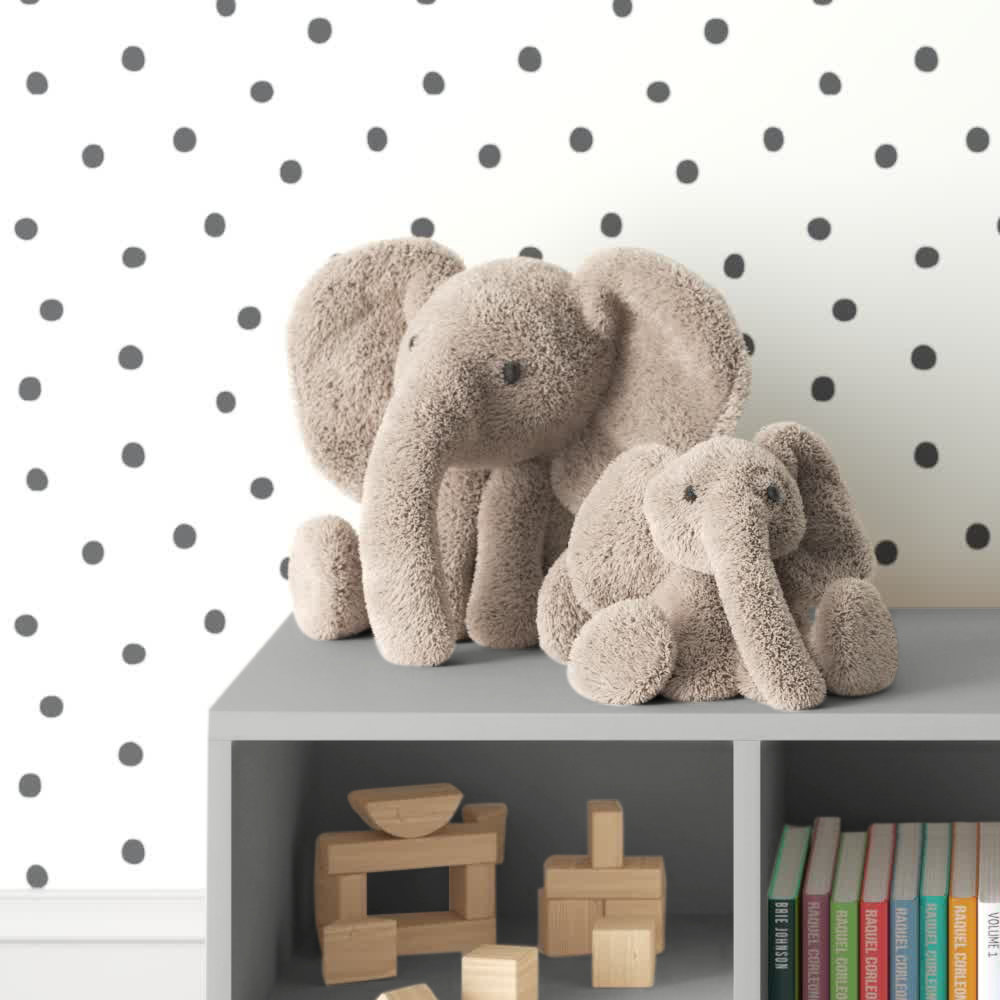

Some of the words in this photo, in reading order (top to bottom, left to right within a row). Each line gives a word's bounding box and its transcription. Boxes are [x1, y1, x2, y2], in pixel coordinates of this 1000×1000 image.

[775, 902, 788, 923] BRIE
[807, 901, 820, 945] RAQUEL
[835, 910, 848, 953] RAQUEL
[865, 909, 877, 953] RAQUEL
[895, 908, 907, 951] RAQUEL
[925, 903, 937, 946] RAQUEL
[954, 905, 967, 948] RAQUEL
[988, 912, 1000, 949] VOLUME
[775, 927, 788, 969] JOHNSON
